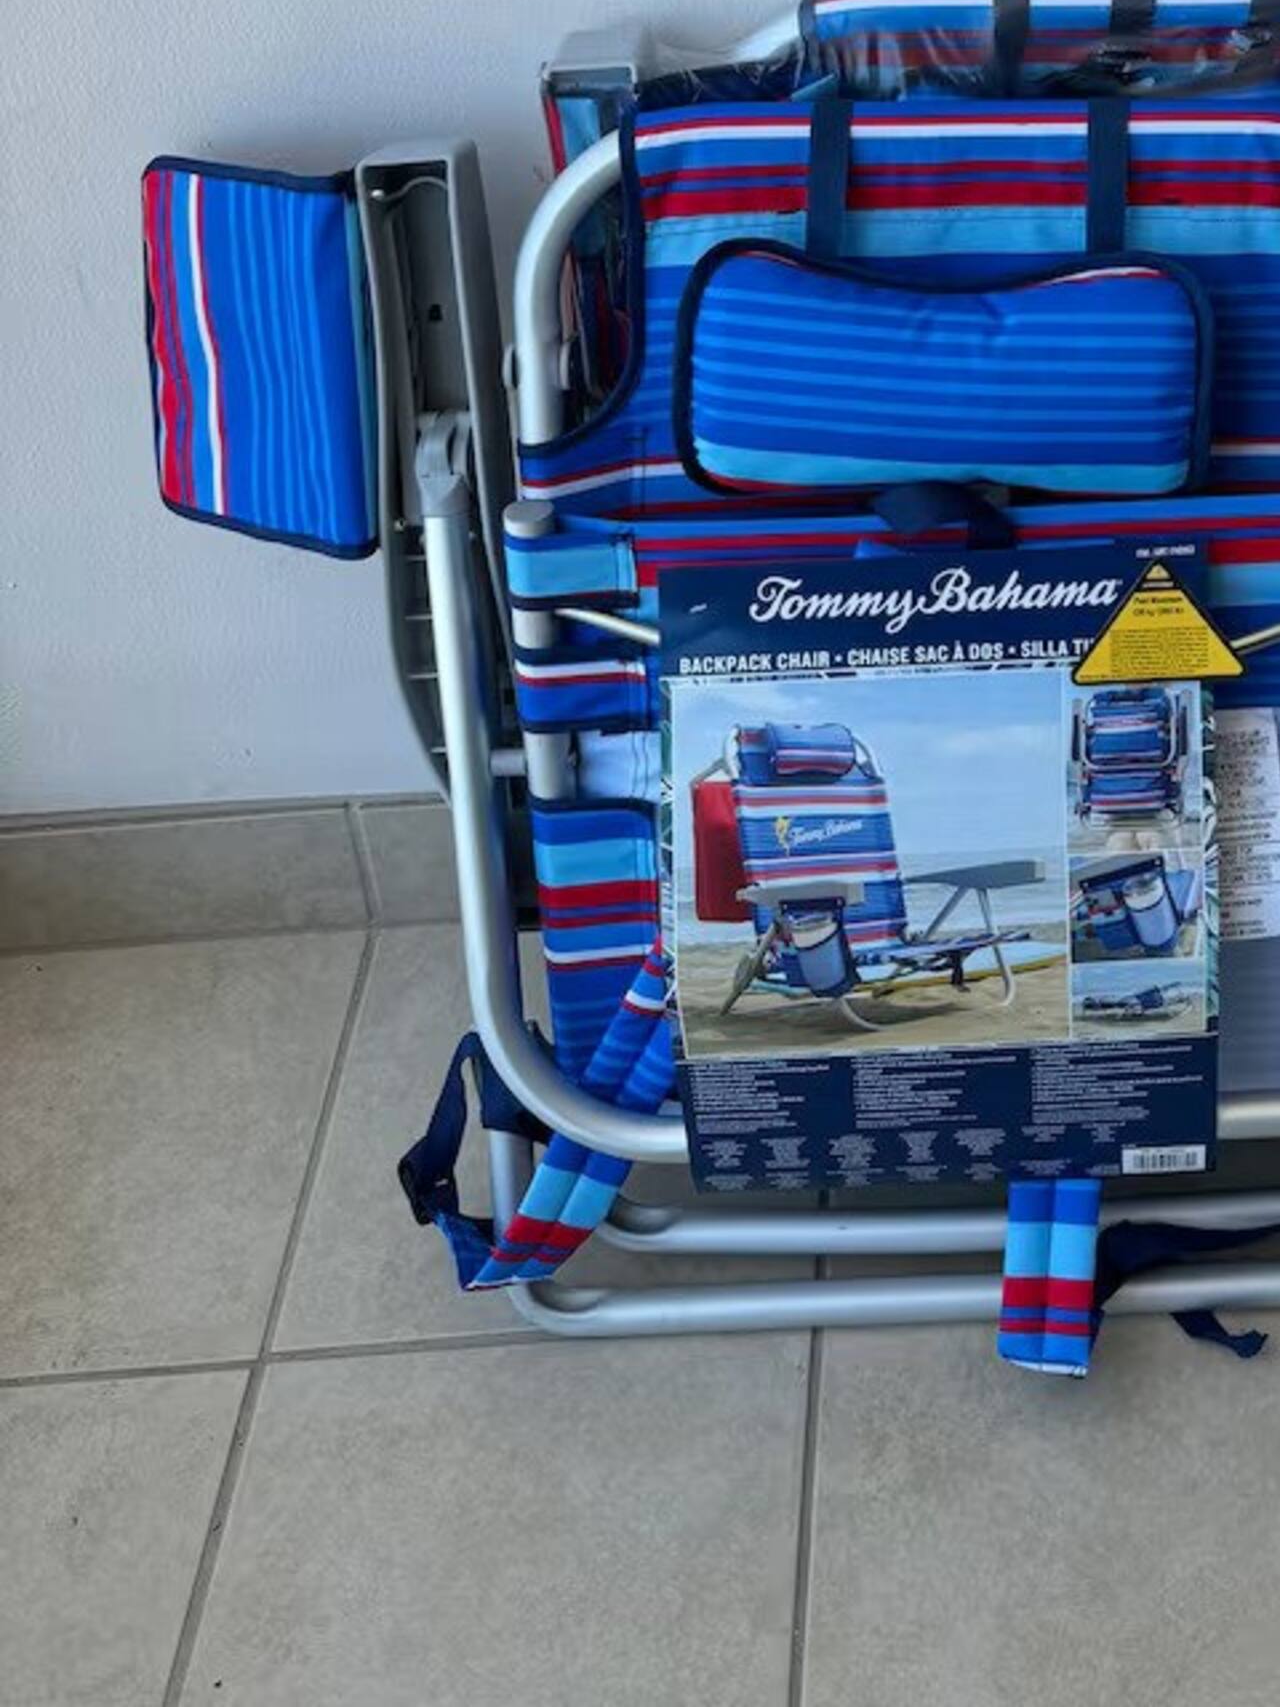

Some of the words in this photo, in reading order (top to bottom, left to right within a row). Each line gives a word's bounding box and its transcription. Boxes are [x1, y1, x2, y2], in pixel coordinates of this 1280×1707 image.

[749, 575, 914, 635] Tommy
[914, 565, 1119, 614] Bahama
[679, 653, 772, 674] BACKPACK
[776, 650, 830, 669] CHAIR
[847, 645, 910, 665] CHAISE
[914, 644, 949, 663] SAC
[953, 640, 965, 661] À
[969, 642, 1004, 660] DOS
[1020, 639, 1068, 658] SILLA
